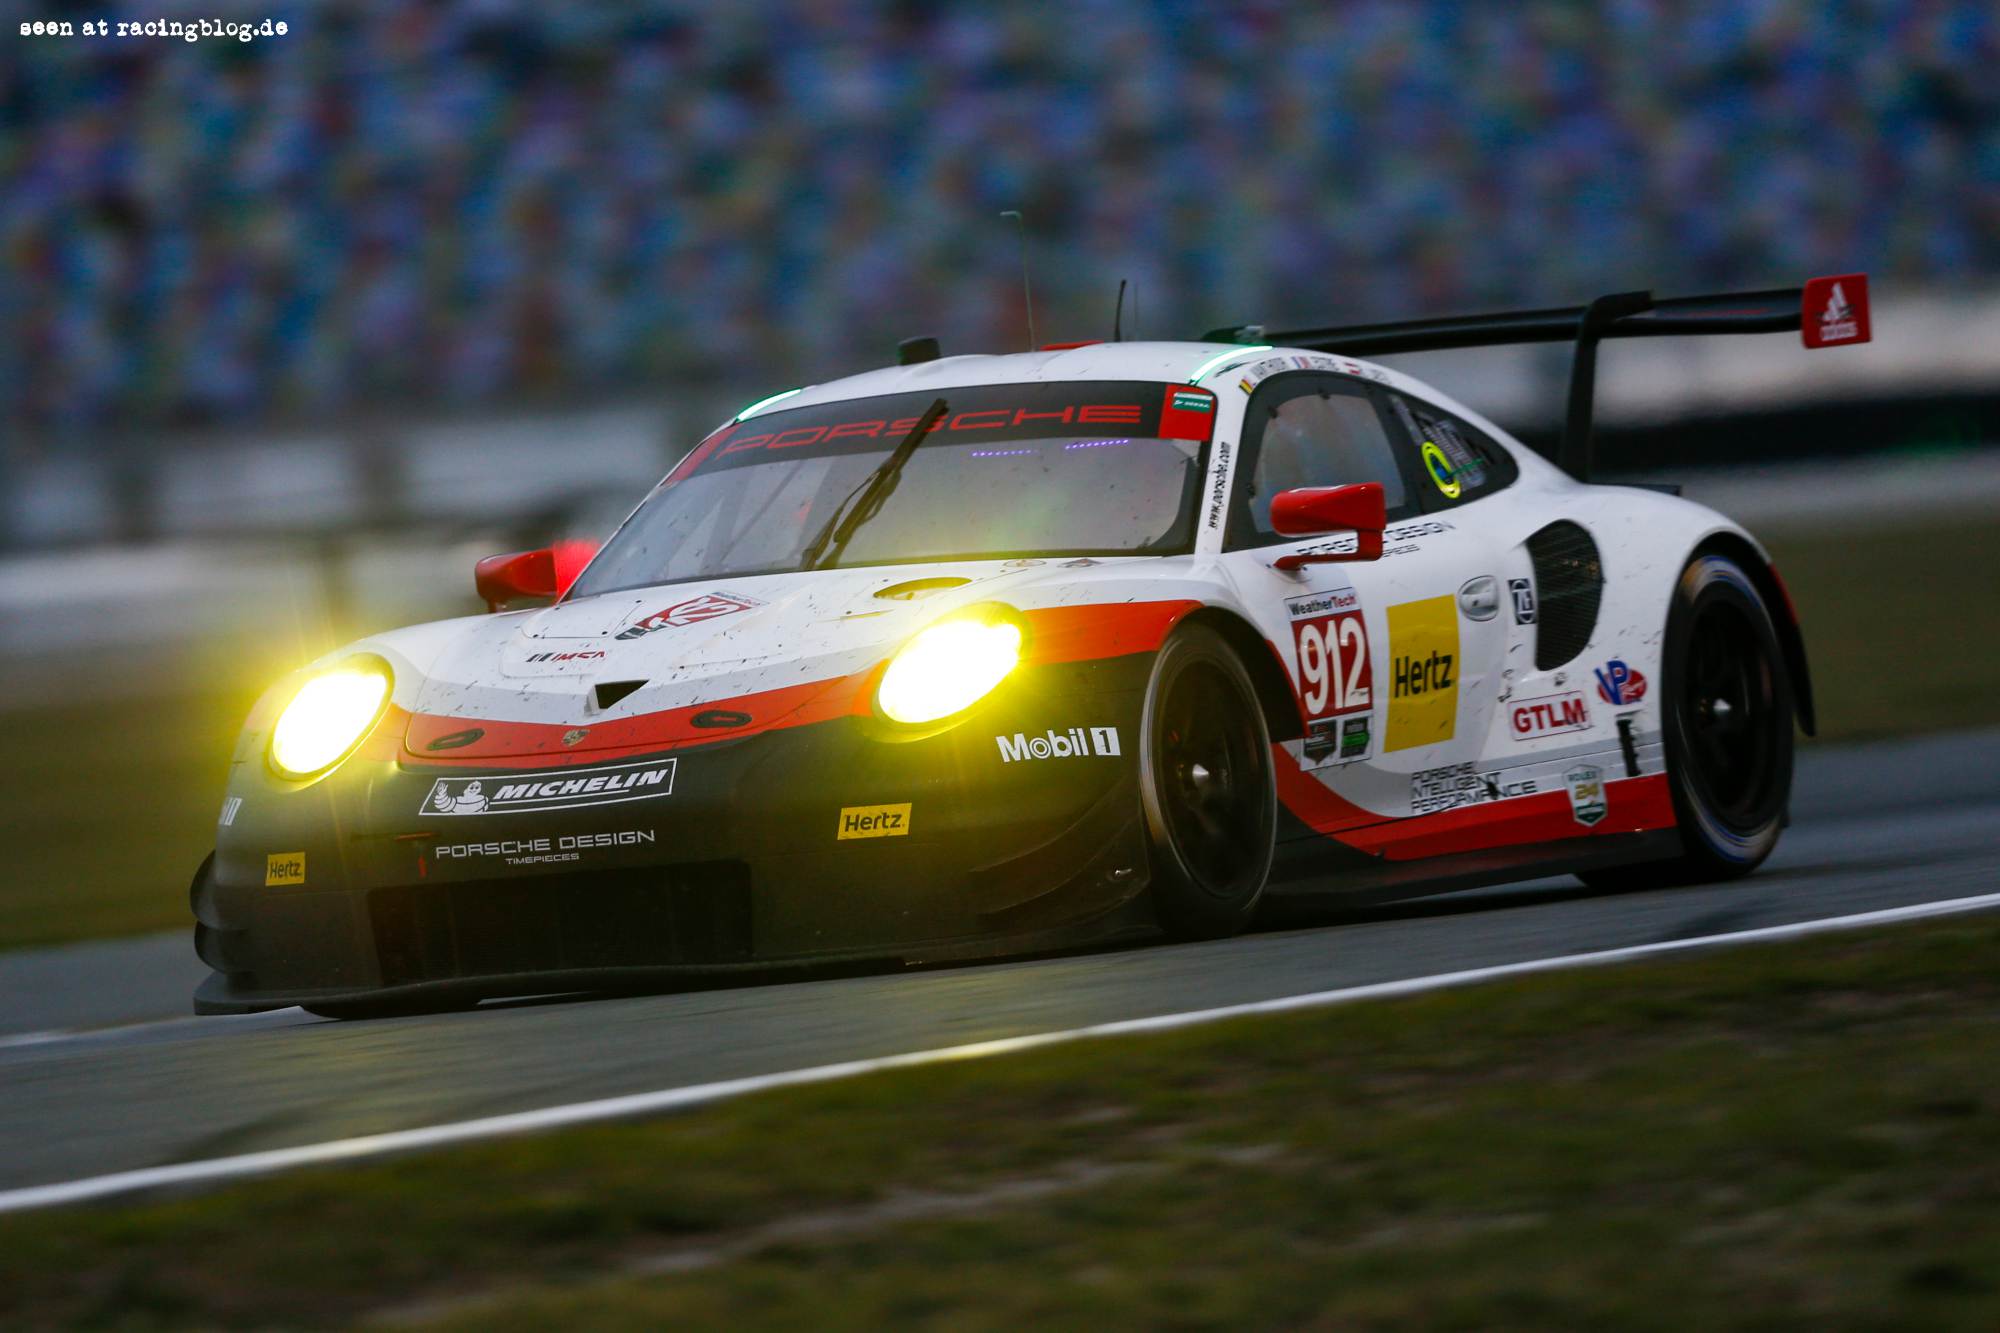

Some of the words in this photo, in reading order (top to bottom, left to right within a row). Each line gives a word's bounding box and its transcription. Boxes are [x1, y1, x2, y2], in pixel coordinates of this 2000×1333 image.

[715, 405, 1141, 461] PORSCHE
[1288, 593, 1357, 616] WeatherTech
[1301, 617, 1370, 714] 912
[1513, 698, 1586, 733] GTLM
[996, 728, 1089, 762] Mobil
[493, 769, 668, 800] MICHELIN
[1411, 761, 1475, 787] PORSCHE
[1575, 783, 1599, 800] 24
[436, 838, 551, 859] PORSCHE
[559, 829, 655, 851] DESIGN
[505, 852, 580, 865] TIMEPIECES
